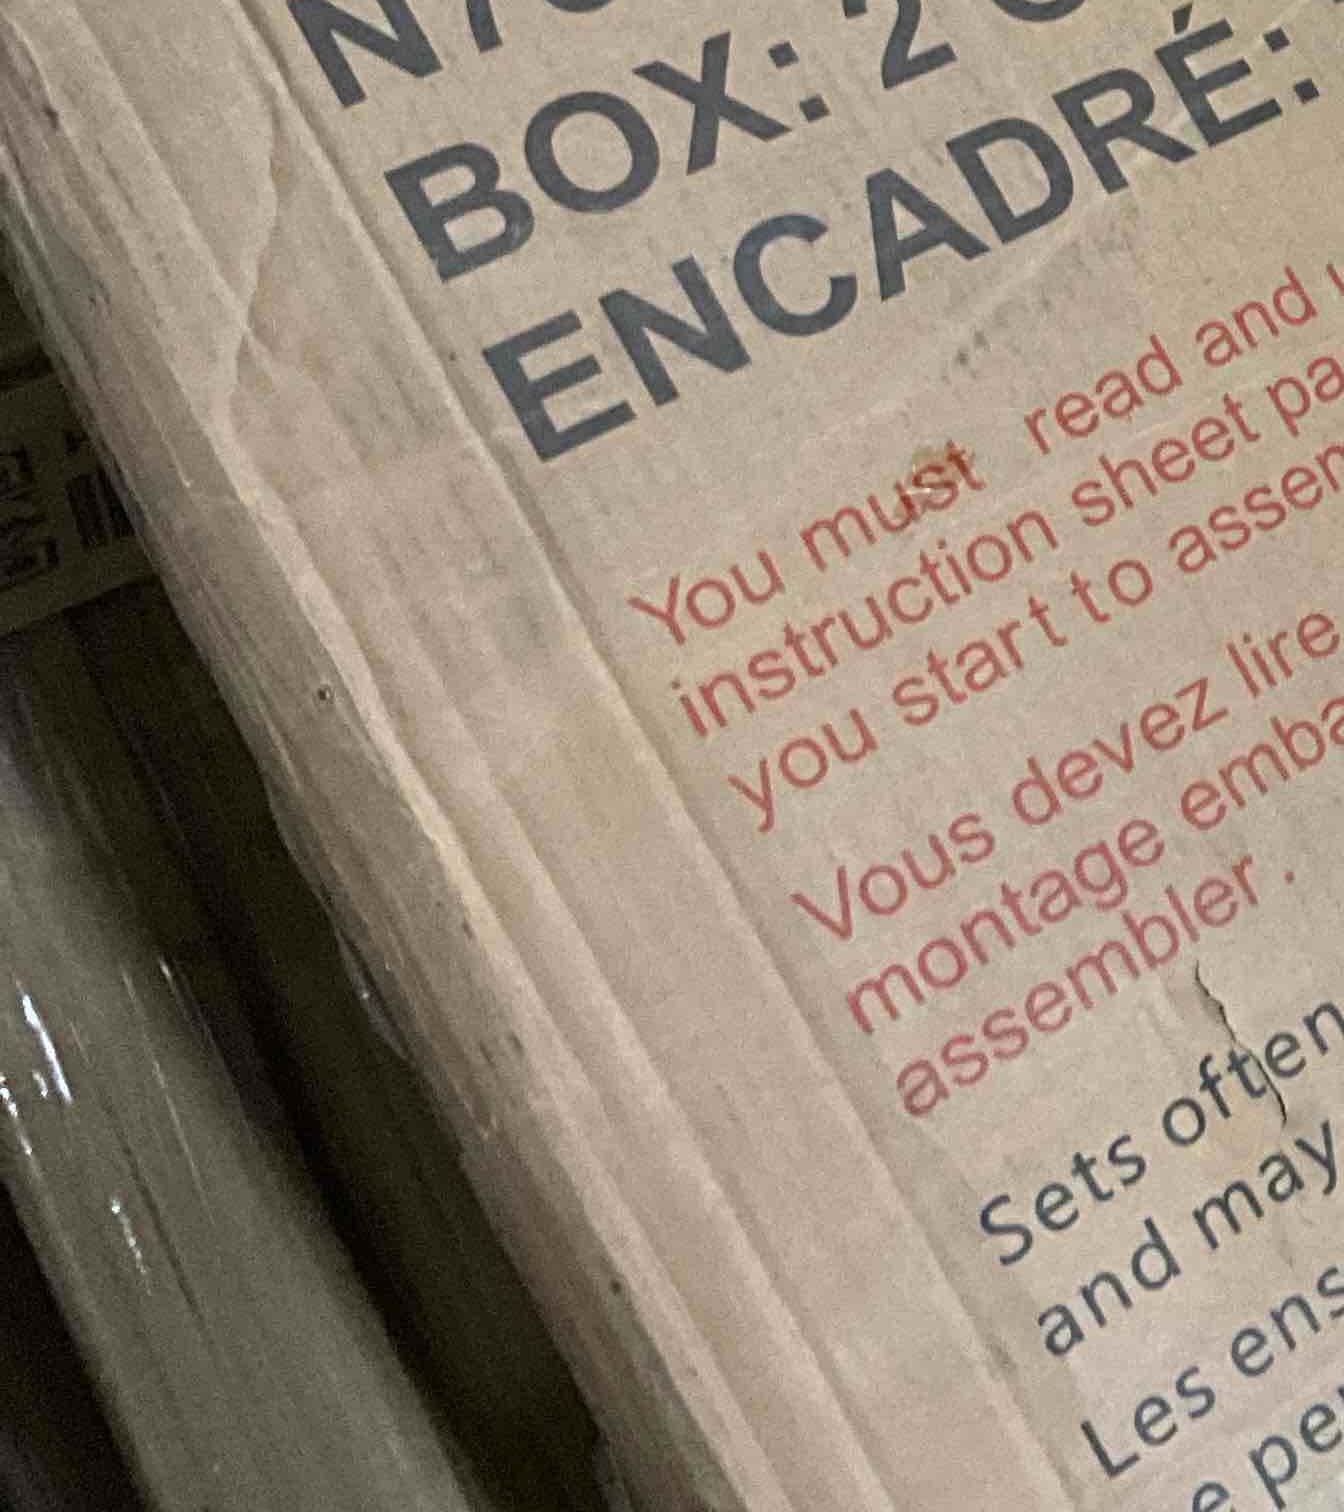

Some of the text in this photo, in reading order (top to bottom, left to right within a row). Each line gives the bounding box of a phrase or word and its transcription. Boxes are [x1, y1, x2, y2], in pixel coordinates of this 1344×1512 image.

[384, 31, 830, 282] BOX:
[483, 3, 1321, 463] ENCADRÉ:
[631, 550, 786, 646] You
[801, 441, 986, 571] must
[1024, 335, 1183, 455] read
[1195, 266, 1318, 368] and
[672, 510, 1058, 737] instruction
[1072, 394, 1260, 526] sheet
[728, 708, 879, 833] you
[893, 595, 1068, 726] start
[1071, 558, 1154, 626] to
[792, 813, 996, 941] Vous
[1011, 677, 1228, 824] devez
[1227, 612, 1341, 699] lire
[846, 818, 1164, 1034] montage
[980, 1133, 1148, 1267] Sets
[1037, 1218, 1181, 1357] and
[1193, 1122, 1338, 1251] may
[1080, 1365, 1216, 1479] Les
